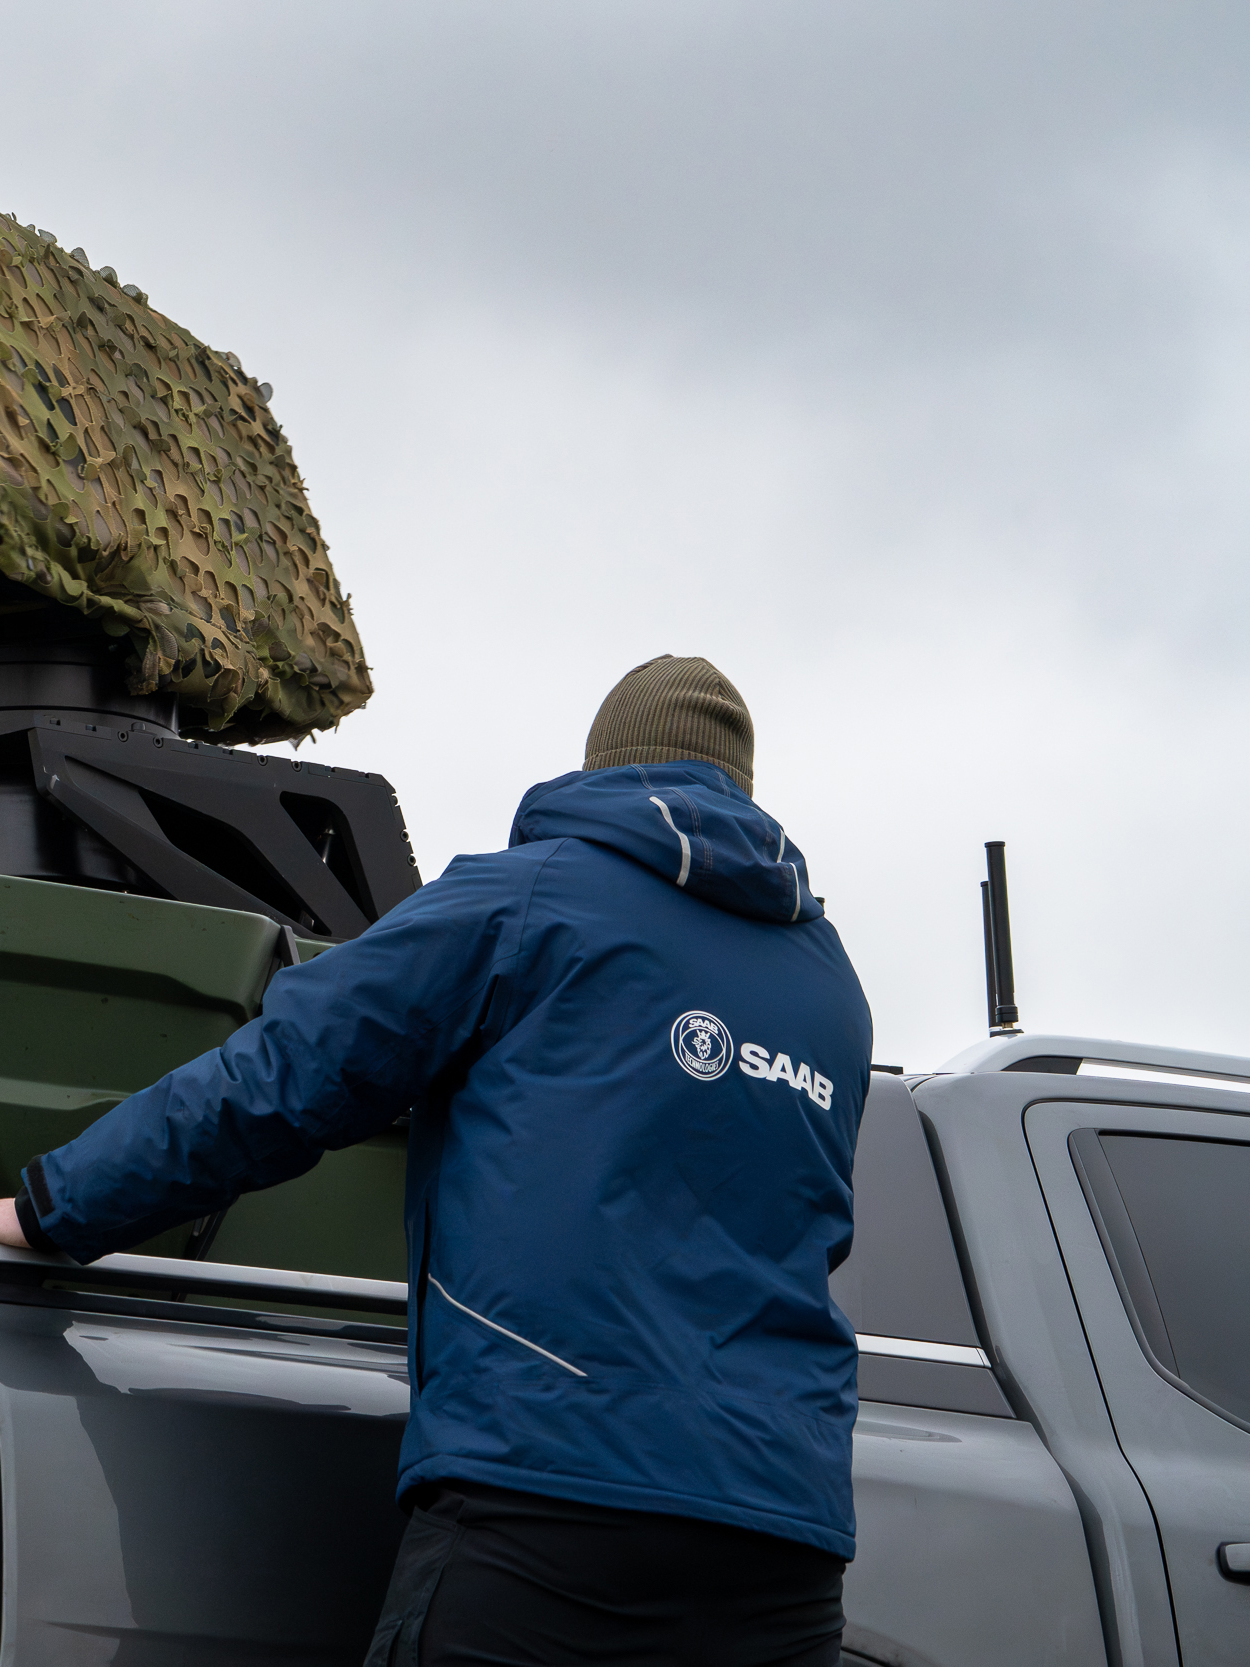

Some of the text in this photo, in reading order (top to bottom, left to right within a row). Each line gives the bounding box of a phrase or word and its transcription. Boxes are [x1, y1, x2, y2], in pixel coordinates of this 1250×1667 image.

[689, 1018, 718, 1034] SAAB
[685, 1052, 719, 1072] TECHNOLOGIES
[738, 1042, 834, 1111] SAAB
